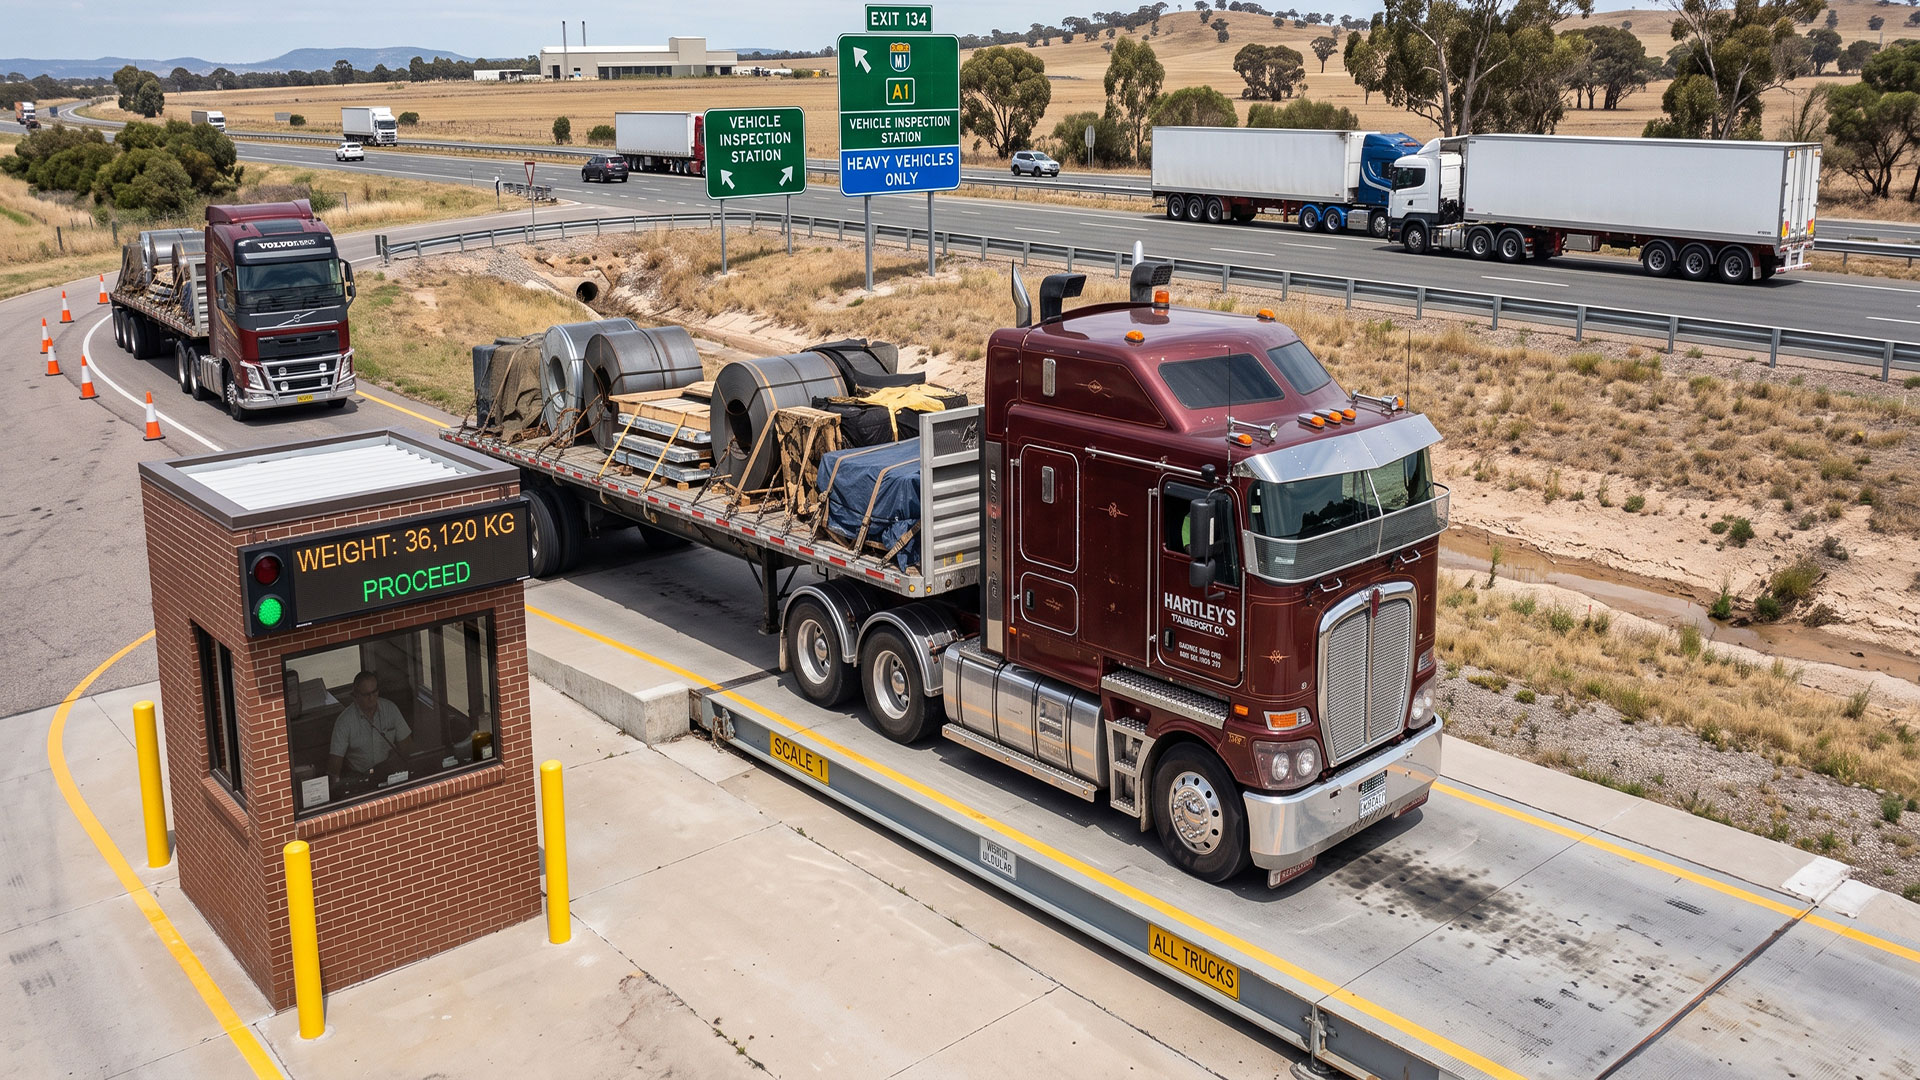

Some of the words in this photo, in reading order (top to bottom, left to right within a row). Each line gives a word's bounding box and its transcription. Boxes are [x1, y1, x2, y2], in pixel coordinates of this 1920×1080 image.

[871, 12, 899, 26] EXIT
[905, 12, 927, 26] 134
[895, 54, 906, 68] M1
[892, 83, 909, 100] A1
[729, 115, 781, 129] VEHICLE
[849, 117, 891, 130] VEHICLE
[894, 115, 950, 128] INSPECTION
[719, 132, 791, 147] INSPECTION
[881, 131, 921, 144] STATION
[731, 149, 782, 163] STATION
[847, 155, 889, 171] HEAVY
[895, 152, 954, 168] VEHICLES
[885, 171, 918, 186] ONLY
[297, 534, 398, 573] WEIGHT:
[405, 519, 477, 552] 36,120
[484, 512, 515, 538] KG
[363, 561, 471, 602] PROCEED
[1164, 592, 1236, 627] HARTLEY'S
[774, 737, 814, 773] SCALE
[818, 759, 823, 777] 1
[1153, 933, 1178, 961] ALL
[1182, 945, 1234, 989] TRUCKS
